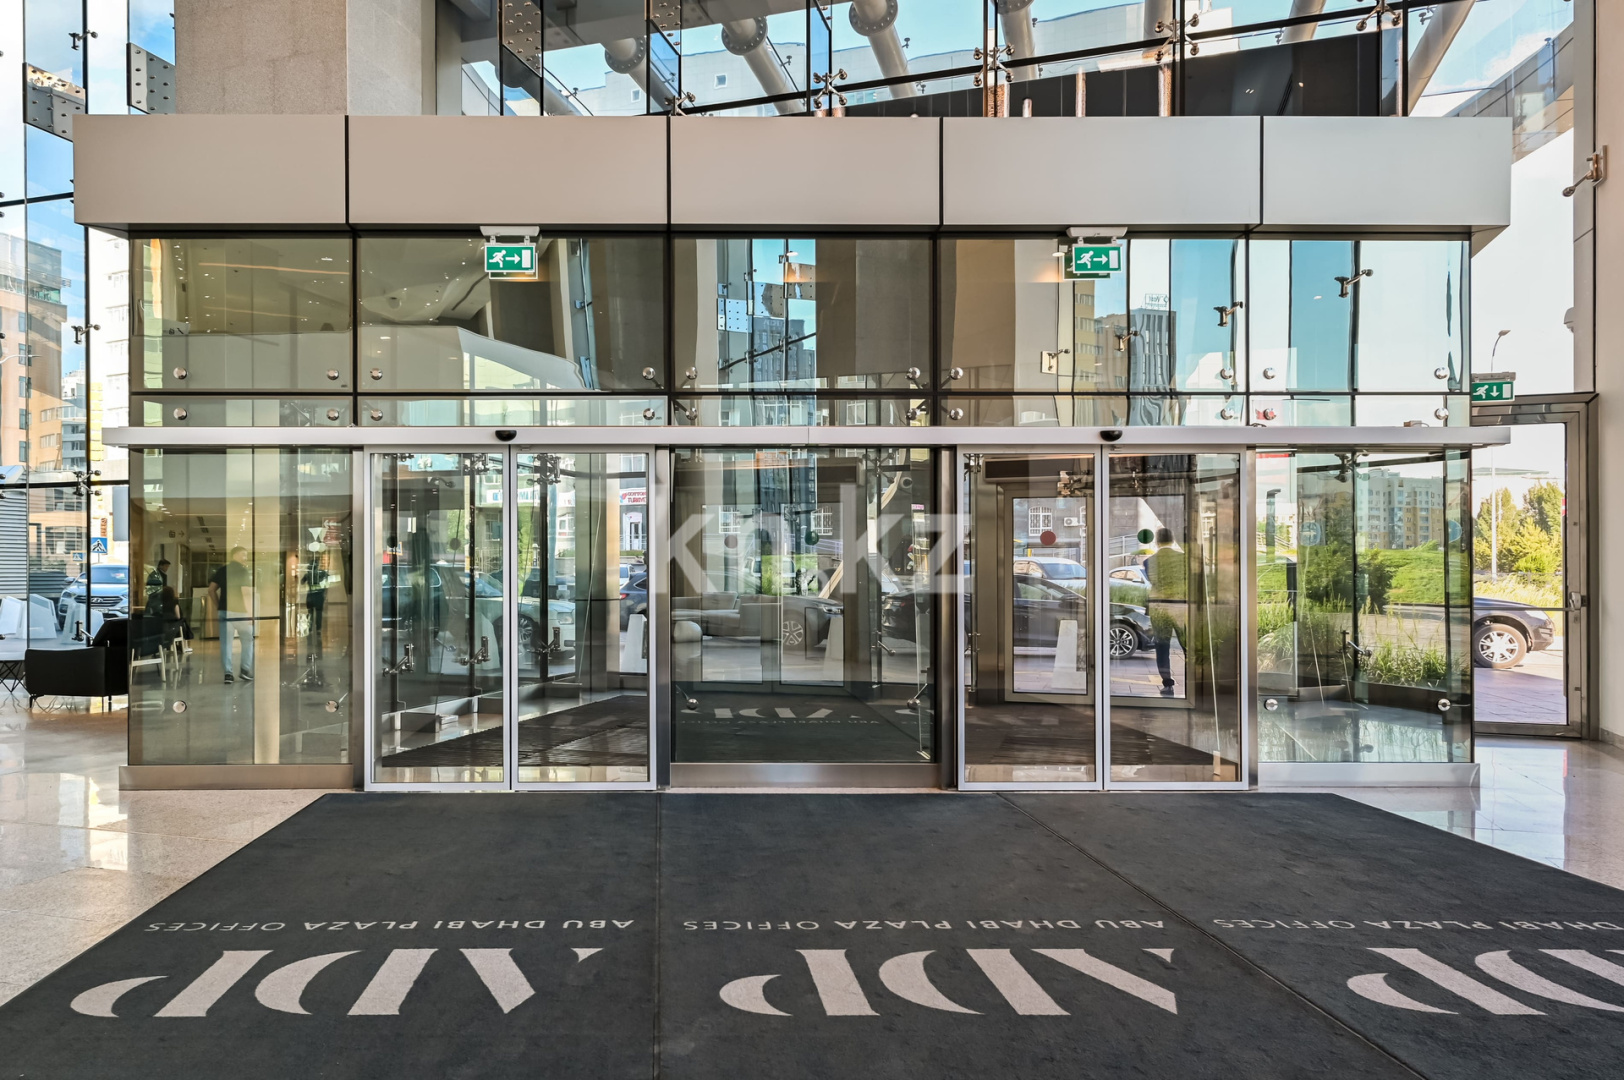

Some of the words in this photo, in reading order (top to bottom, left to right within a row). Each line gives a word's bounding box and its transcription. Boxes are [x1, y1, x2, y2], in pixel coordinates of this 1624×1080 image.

[144, 921, 286, 932] OFFICES
[303, 920, 419, 931] PLAZA
[433, 919, 546, 930] DHABI
[562, 919, 635, 929] ABU
[683, 920, 820, 931] OFFICES
[834, 920, 952, 930] PLAZA
[966, 919, 1082, 929] DHABI
[1094, 919, 1164, 929] ABU
[1212, 919, 1356, 929] OFFICES
[1362, 920, 1493, 930] PLAZA
